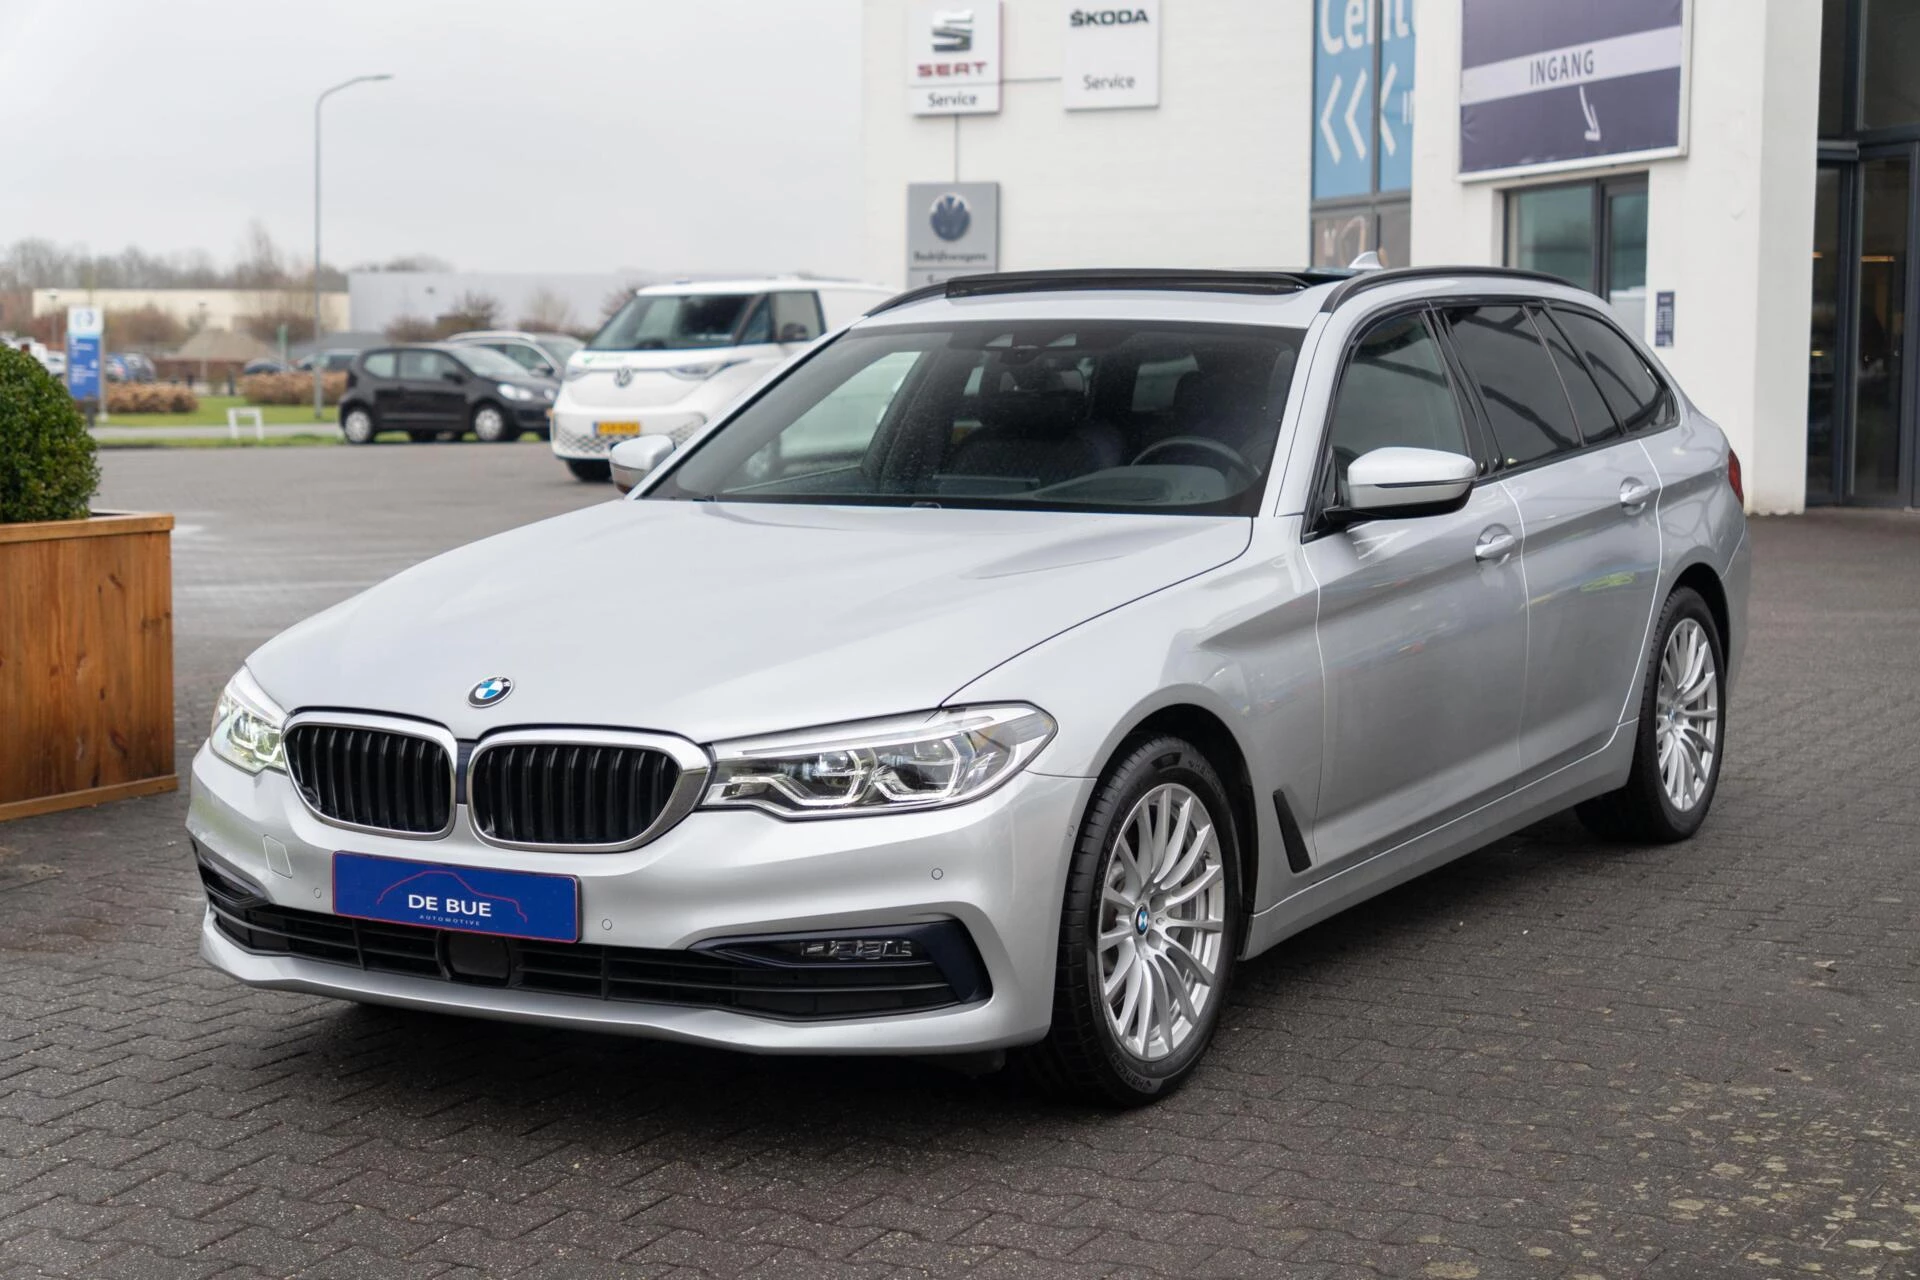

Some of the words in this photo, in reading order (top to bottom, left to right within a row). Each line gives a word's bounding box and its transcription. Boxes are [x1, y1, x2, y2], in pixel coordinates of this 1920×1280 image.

[1321, 0, 1416, 54] Cent
[917, 62, 987, 77] SEAT
[1530, 49, 1595, 85] INGANG
[1083, 74, 1136, 90] Service
[928, 91, 977, 107] Service
[408, 894, 438, 911] DE
[446, 898, 492, 917] BUE
[419, 914, 480, 926] AUTOMOTIVE
